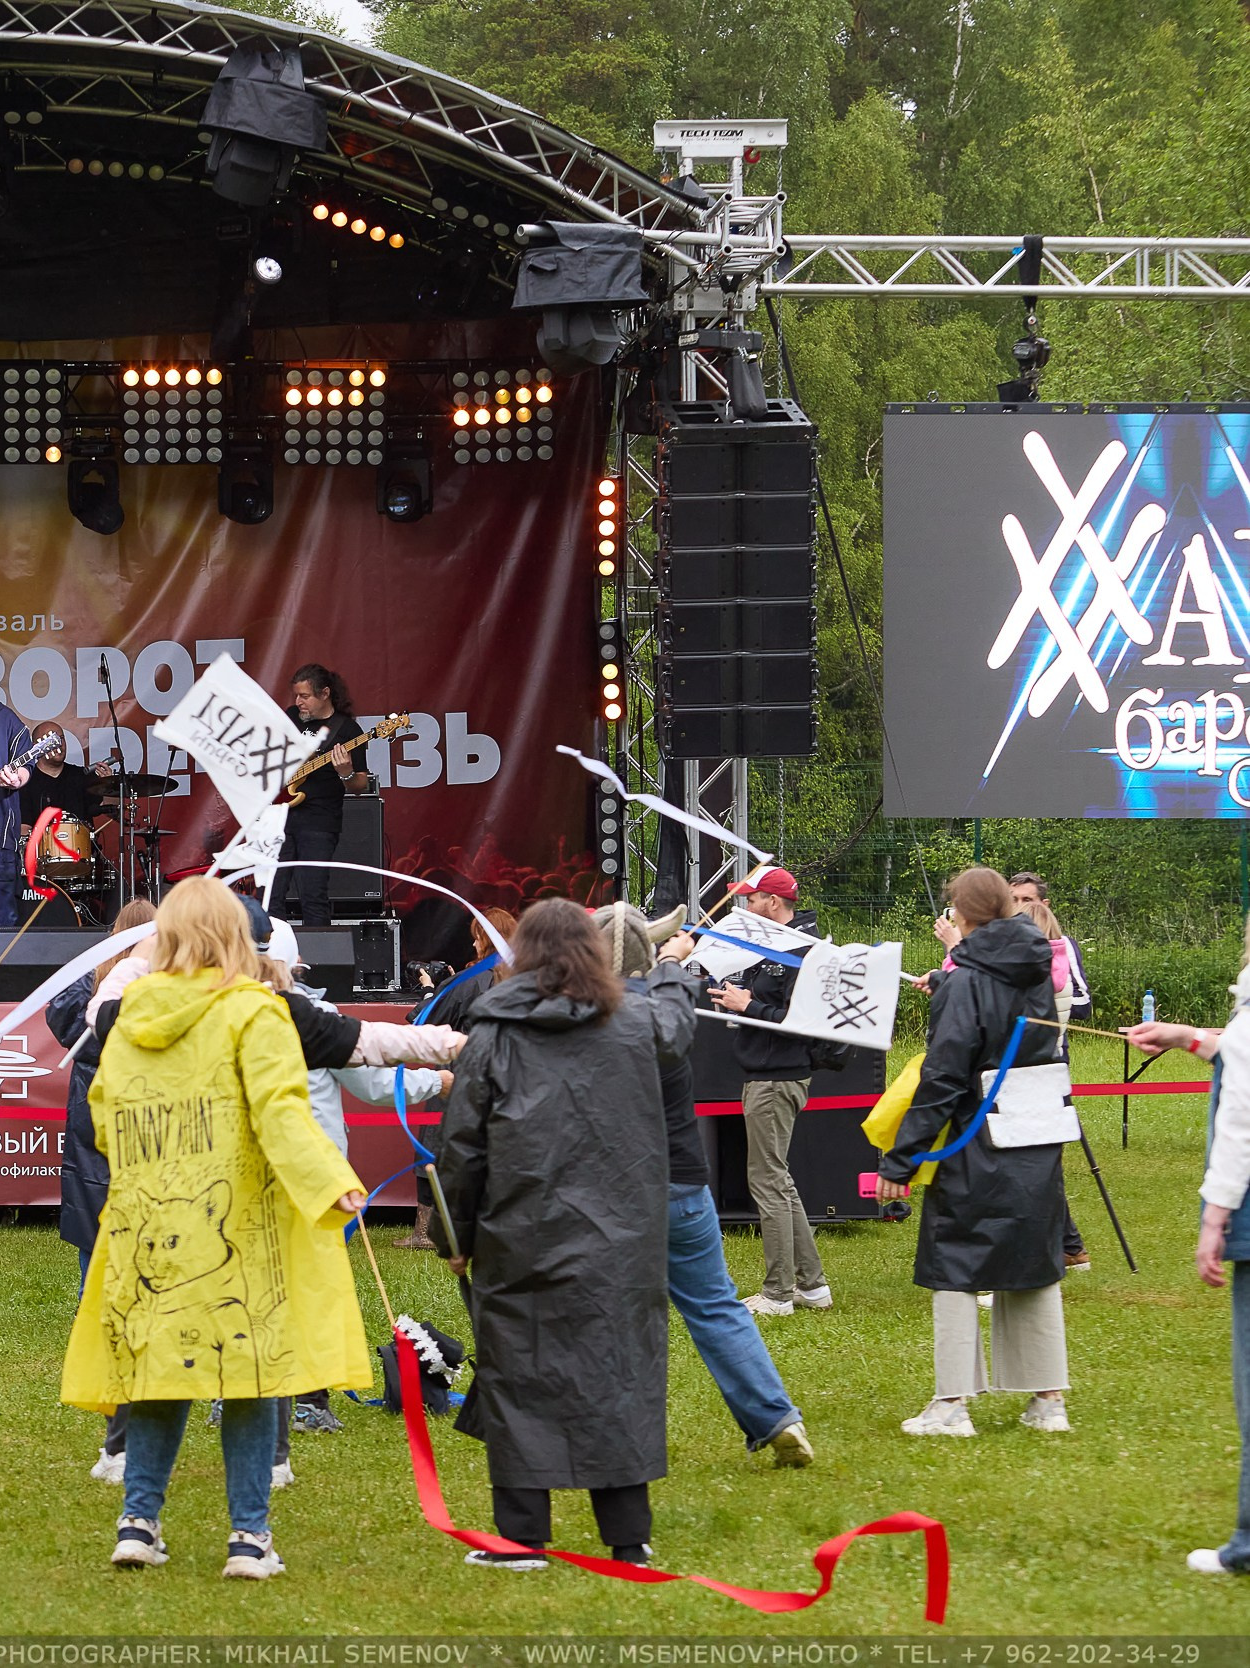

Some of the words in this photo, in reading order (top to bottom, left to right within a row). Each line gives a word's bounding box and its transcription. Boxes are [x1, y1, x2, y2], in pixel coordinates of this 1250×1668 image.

[680, 129, 710, 137] TECH
[713, 129, 743, 137] TEAM
[1114, 687, 1250, 808] бар
